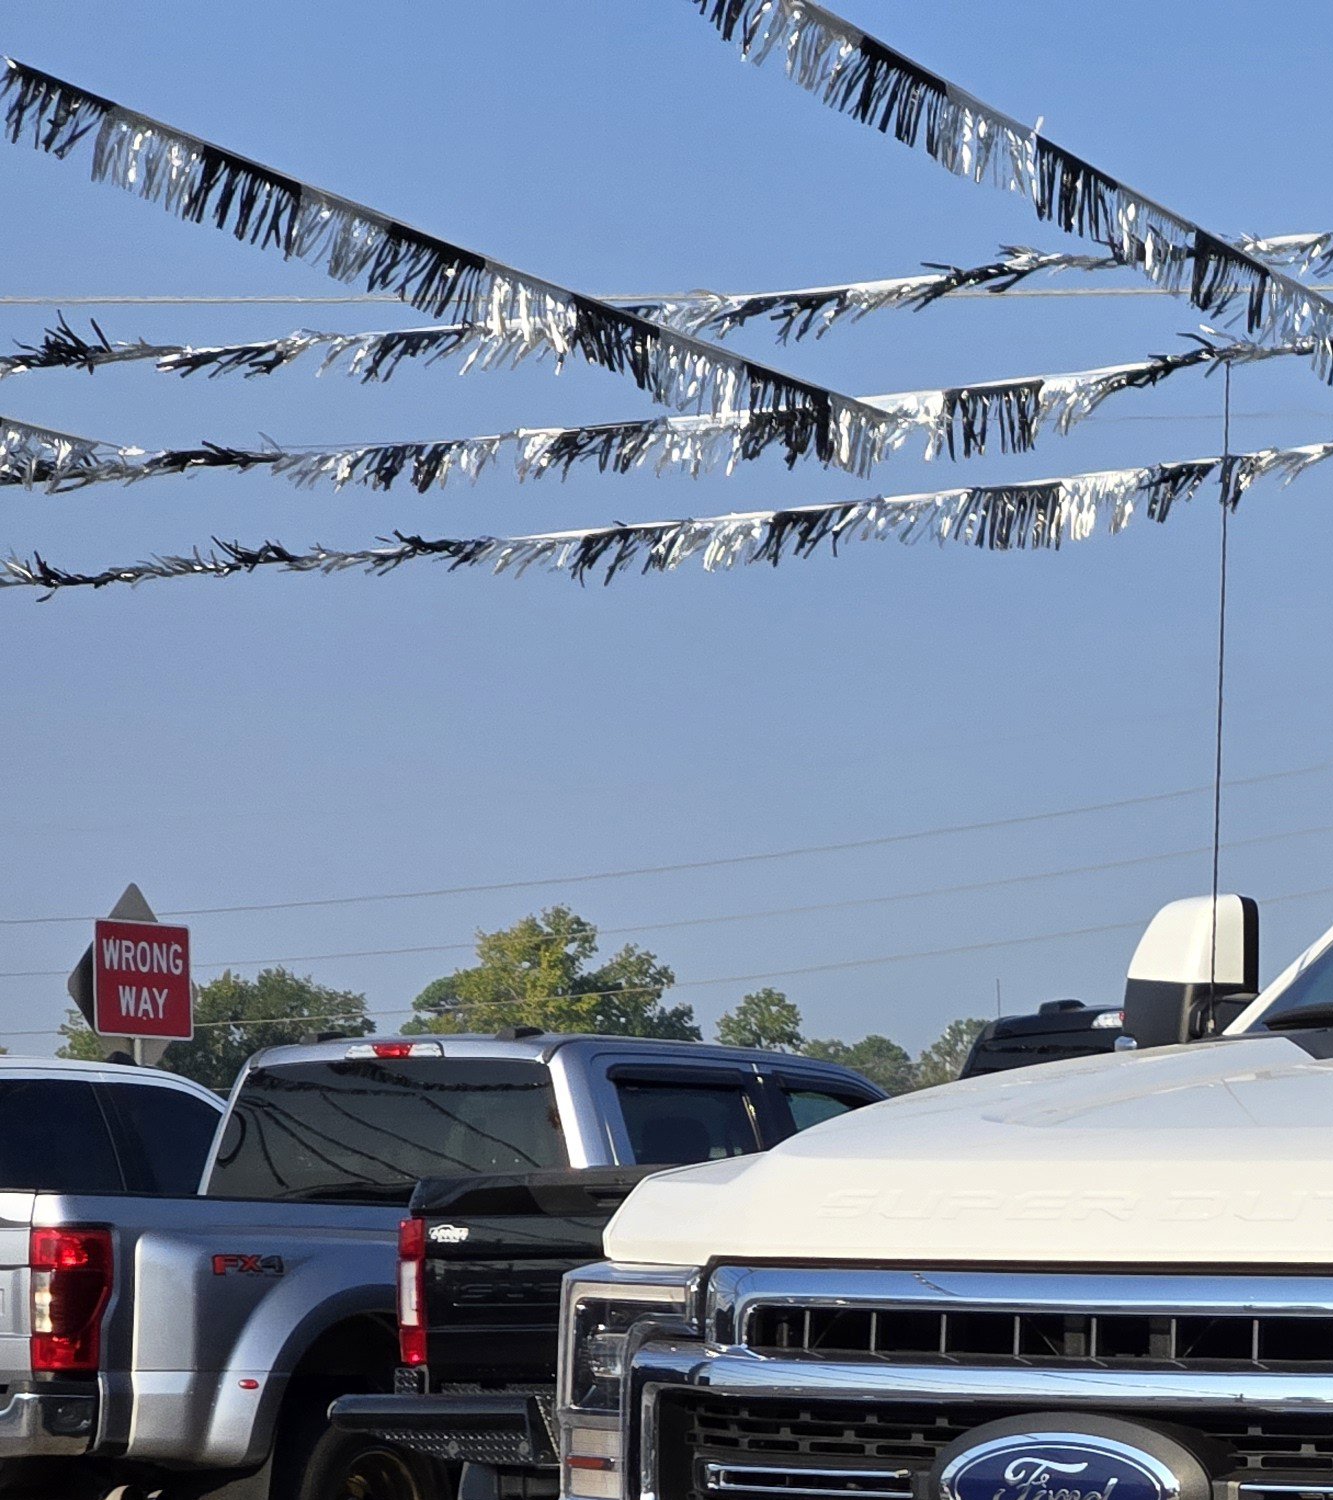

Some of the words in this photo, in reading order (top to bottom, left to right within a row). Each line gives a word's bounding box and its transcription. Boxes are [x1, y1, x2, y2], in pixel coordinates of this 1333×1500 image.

[102, 938, 183, 975] WRONG
[118, 985, 168, 1019] WAY
[815, 1188, 1142, 1223] SUPER
[212, 1254, 284, 1276] FX4
